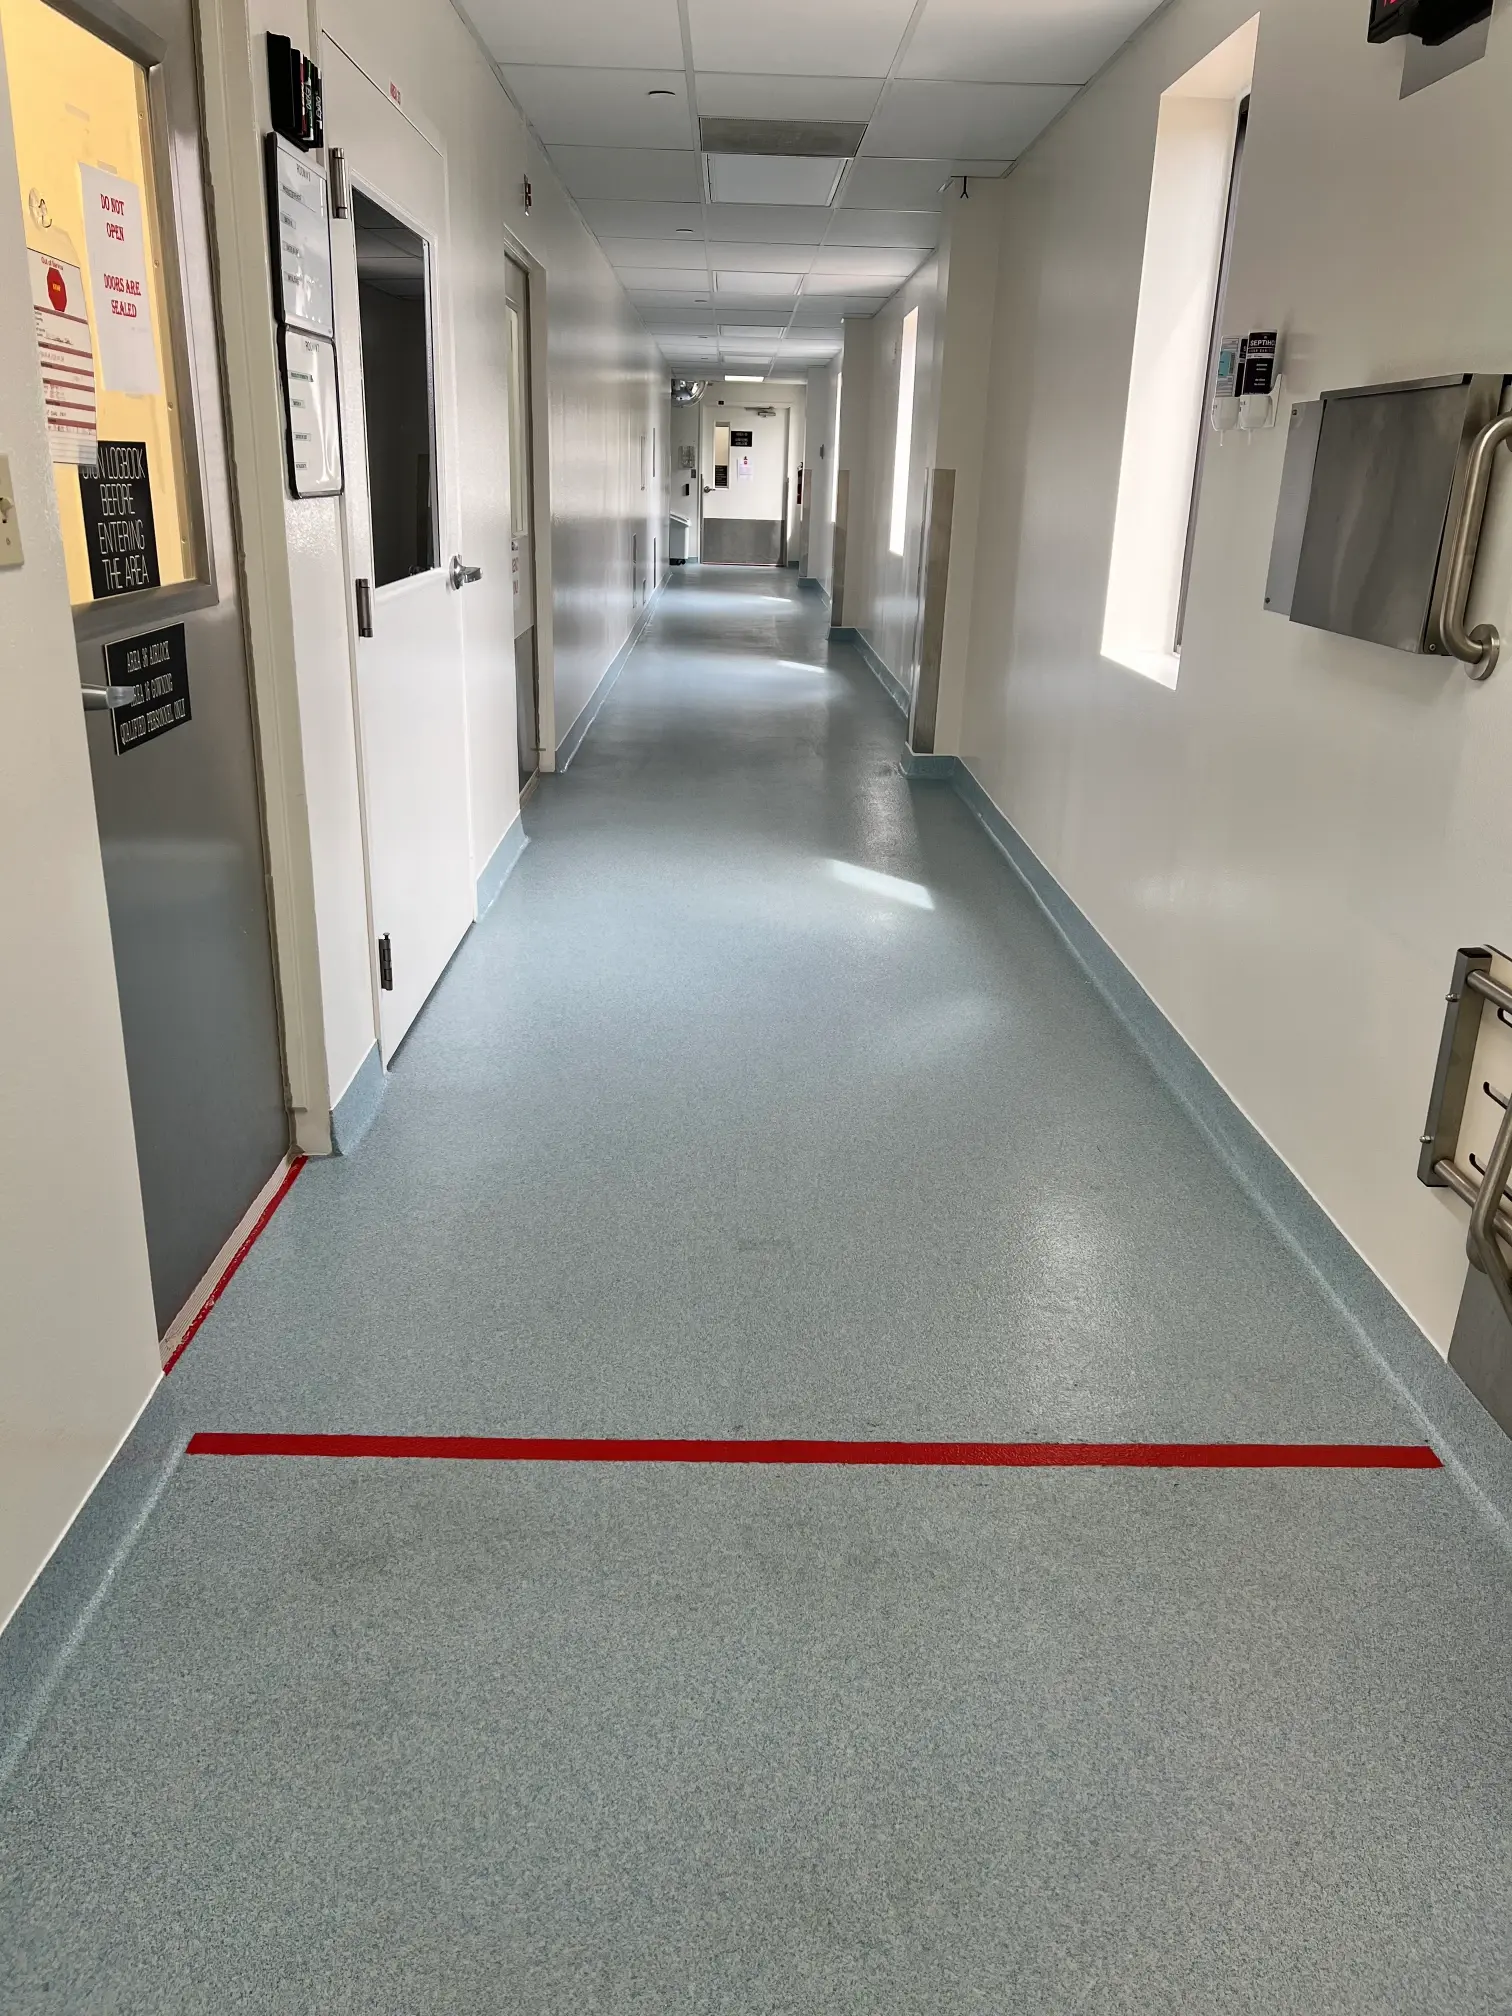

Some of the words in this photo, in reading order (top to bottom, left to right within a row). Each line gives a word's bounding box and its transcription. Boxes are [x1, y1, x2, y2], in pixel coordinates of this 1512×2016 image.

[100, 194, 110, 211] DO
[110, 198, 125, 216] NOT
[106, 222, 125, 241] OPEN
[103, 273, 125, 293] DOORS
[125, 279, 142, 297] ARE
[110, 299, 137, 318] SEALED
[105, 447, 146, 480] LOGBOOK
[100, 483, 136, 516] BEFORE
[98, 519, 145, 555] ENTERING
[102, 558, 123, 591] THE
[125, 555, 149, 588] AREA
[126, 650, 141, 673] AREA
[130, 684, 145, 708] REA
[120, 714, 147, 746] QUALIFIED
[146, 703, 175, 733] PERSONNEL
[173, 698, 186, 720] ONLY
